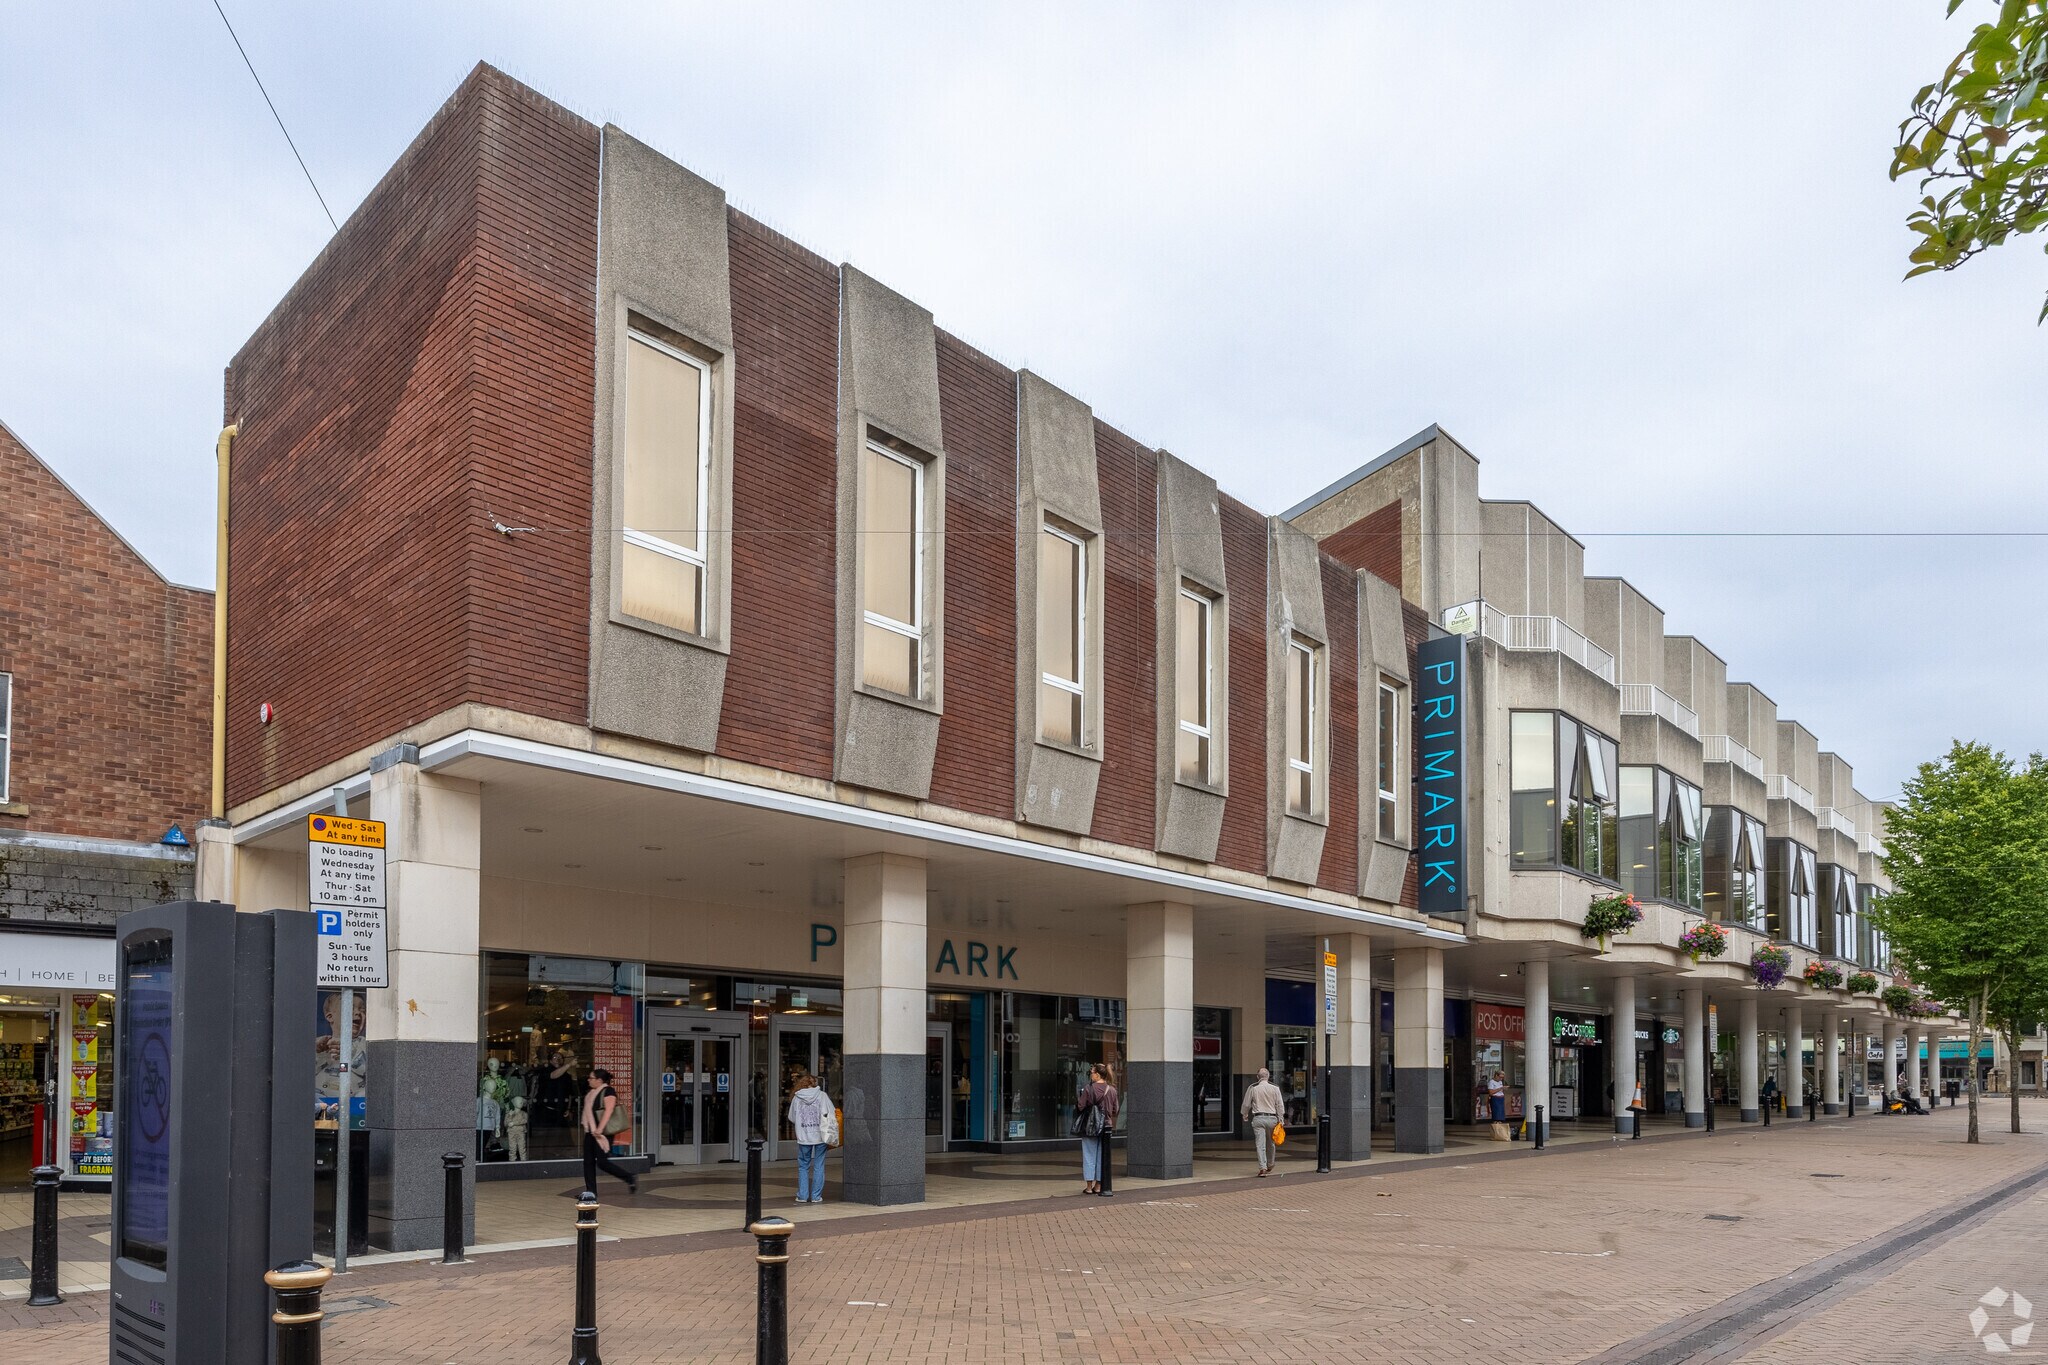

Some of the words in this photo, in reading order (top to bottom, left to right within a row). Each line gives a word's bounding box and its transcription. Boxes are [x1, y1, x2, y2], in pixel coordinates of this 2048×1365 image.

[332, 820, 353, 830] Wed
[360, 823, 376, 833] Sat
[326, 830, 338, 839] At
[341, 833, 358, 842] any
[361, 834, 381, 843] time
[322, 846, 336, 855] No
[339, 848, 374, 860] loading
[321, 858, 375, 871] Wednesday
[320, 869, 332, 877] At
[335, 872, 352, 880] any
[355, 872, 376, 881] time
[325, 881, 347, 890] Thur
[355, 884, 372, 892] Sat
[320, 892, 331, 900] 10
[348, 910, 378, 919] Permit
[322, 914, 338, 932] P
[345, 920, 380, 928] holders
[353, 930, 373, 939] only
[328, 942, 347, 950] Sun
[355, 943, 371, 951] Tue
[811, 923, 1019, 981] PARK
[31, 971, 75, 980] HOME
[360, 975, 381, 983] hour
[1478, 1012, 1502, 1030] POST
